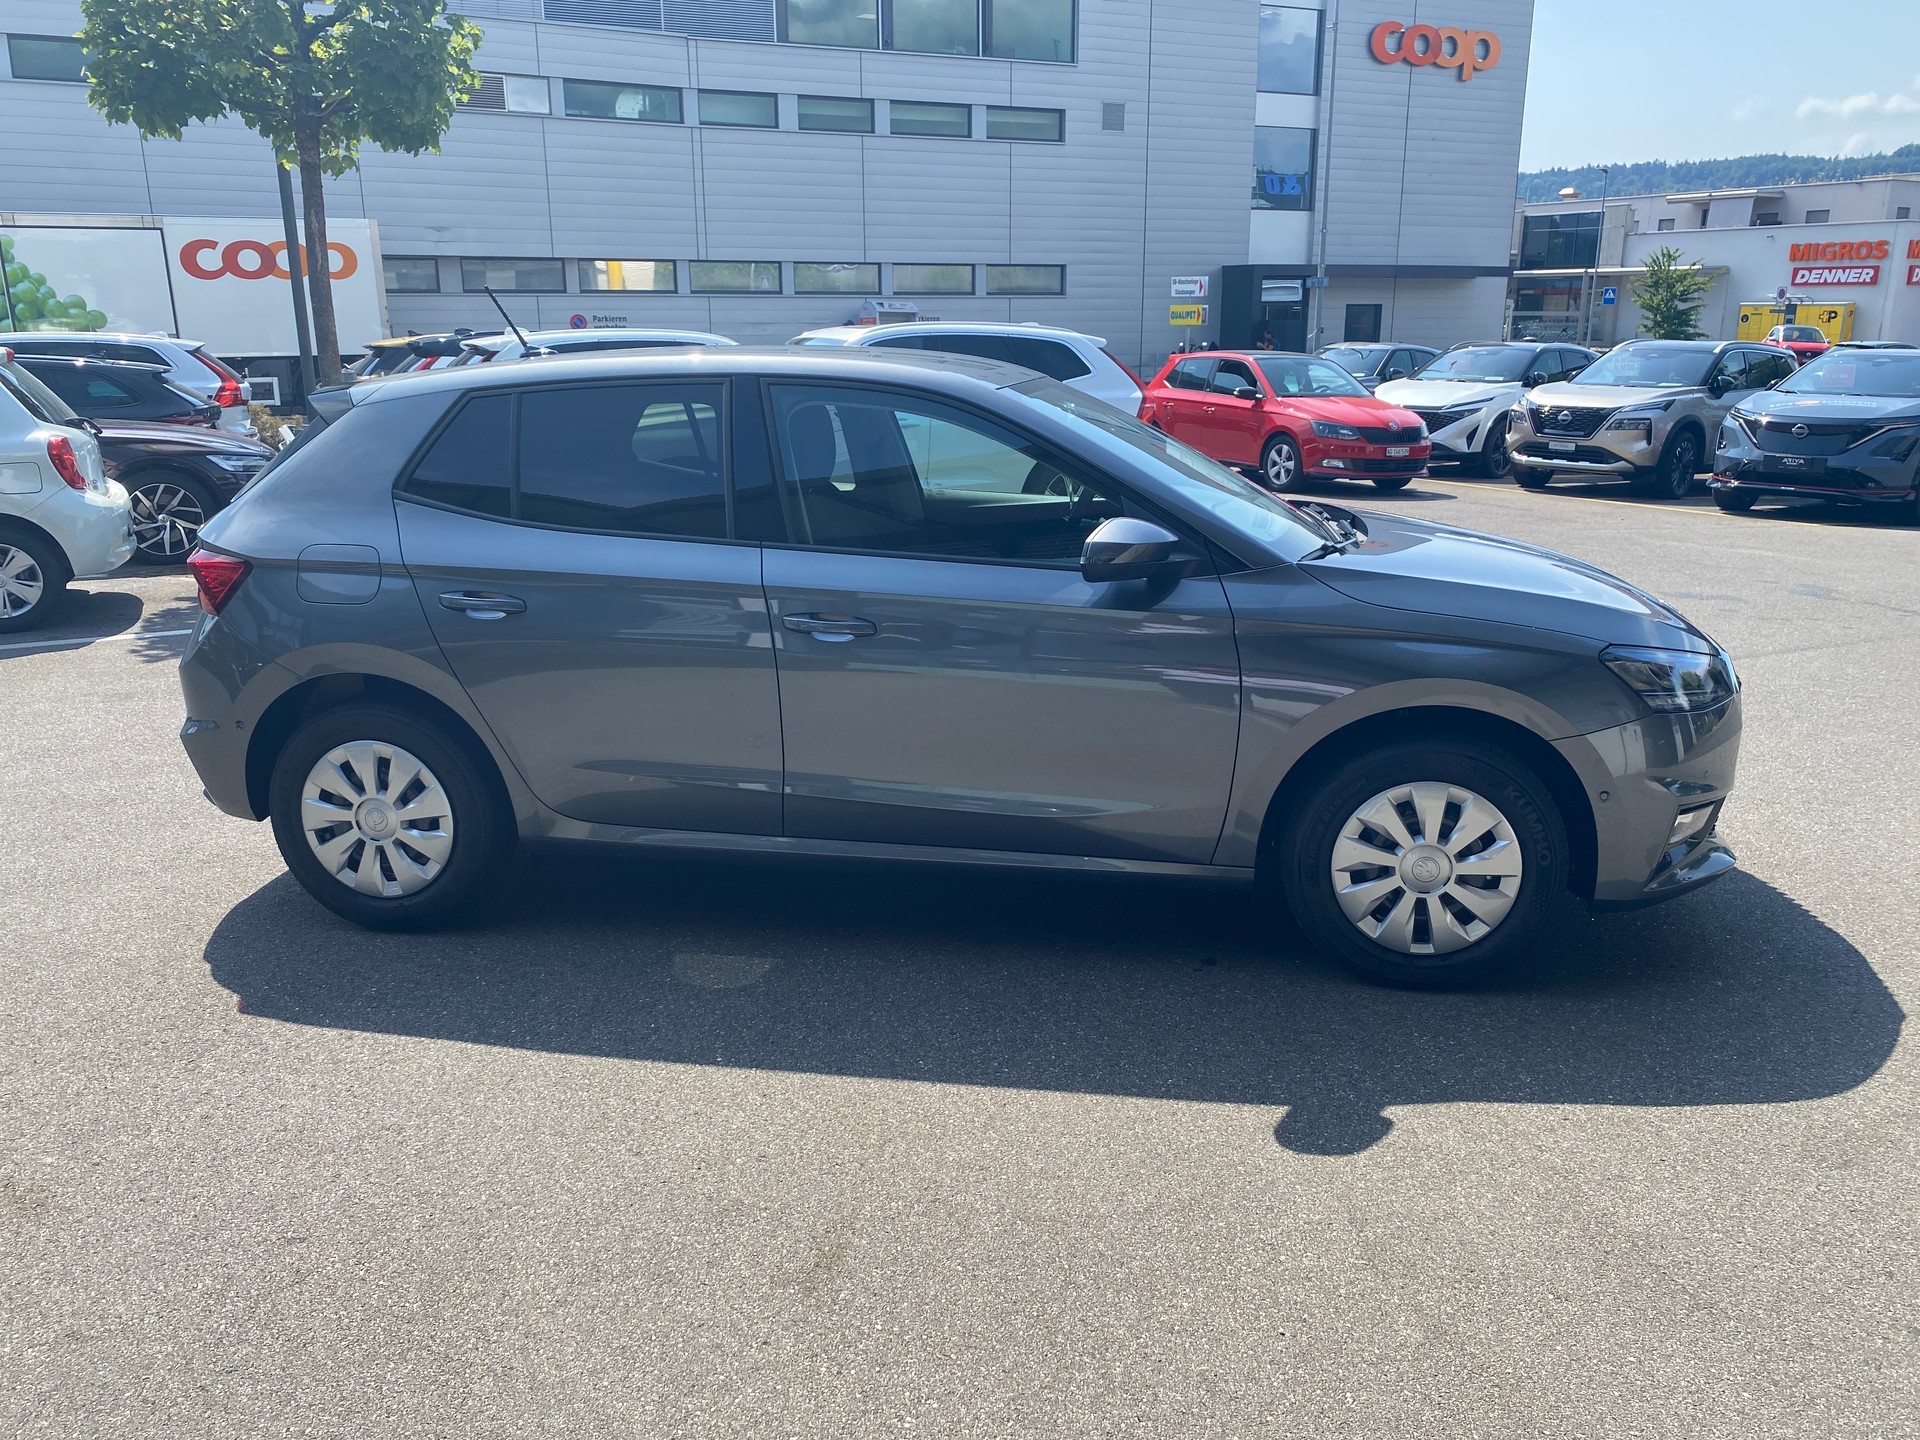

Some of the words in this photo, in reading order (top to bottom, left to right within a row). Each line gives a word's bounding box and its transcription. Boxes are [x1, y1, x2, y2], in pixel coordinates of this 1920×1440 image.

[1789, 240, 1889, 261] MIGROS
[1795, 268, 1874, 284] DENNER
[592, 314, 628, 322] Parkieren
[1171, 310, 1196, 320] QUALIPET
[1503, 784, 1551, 867] KUMHO
